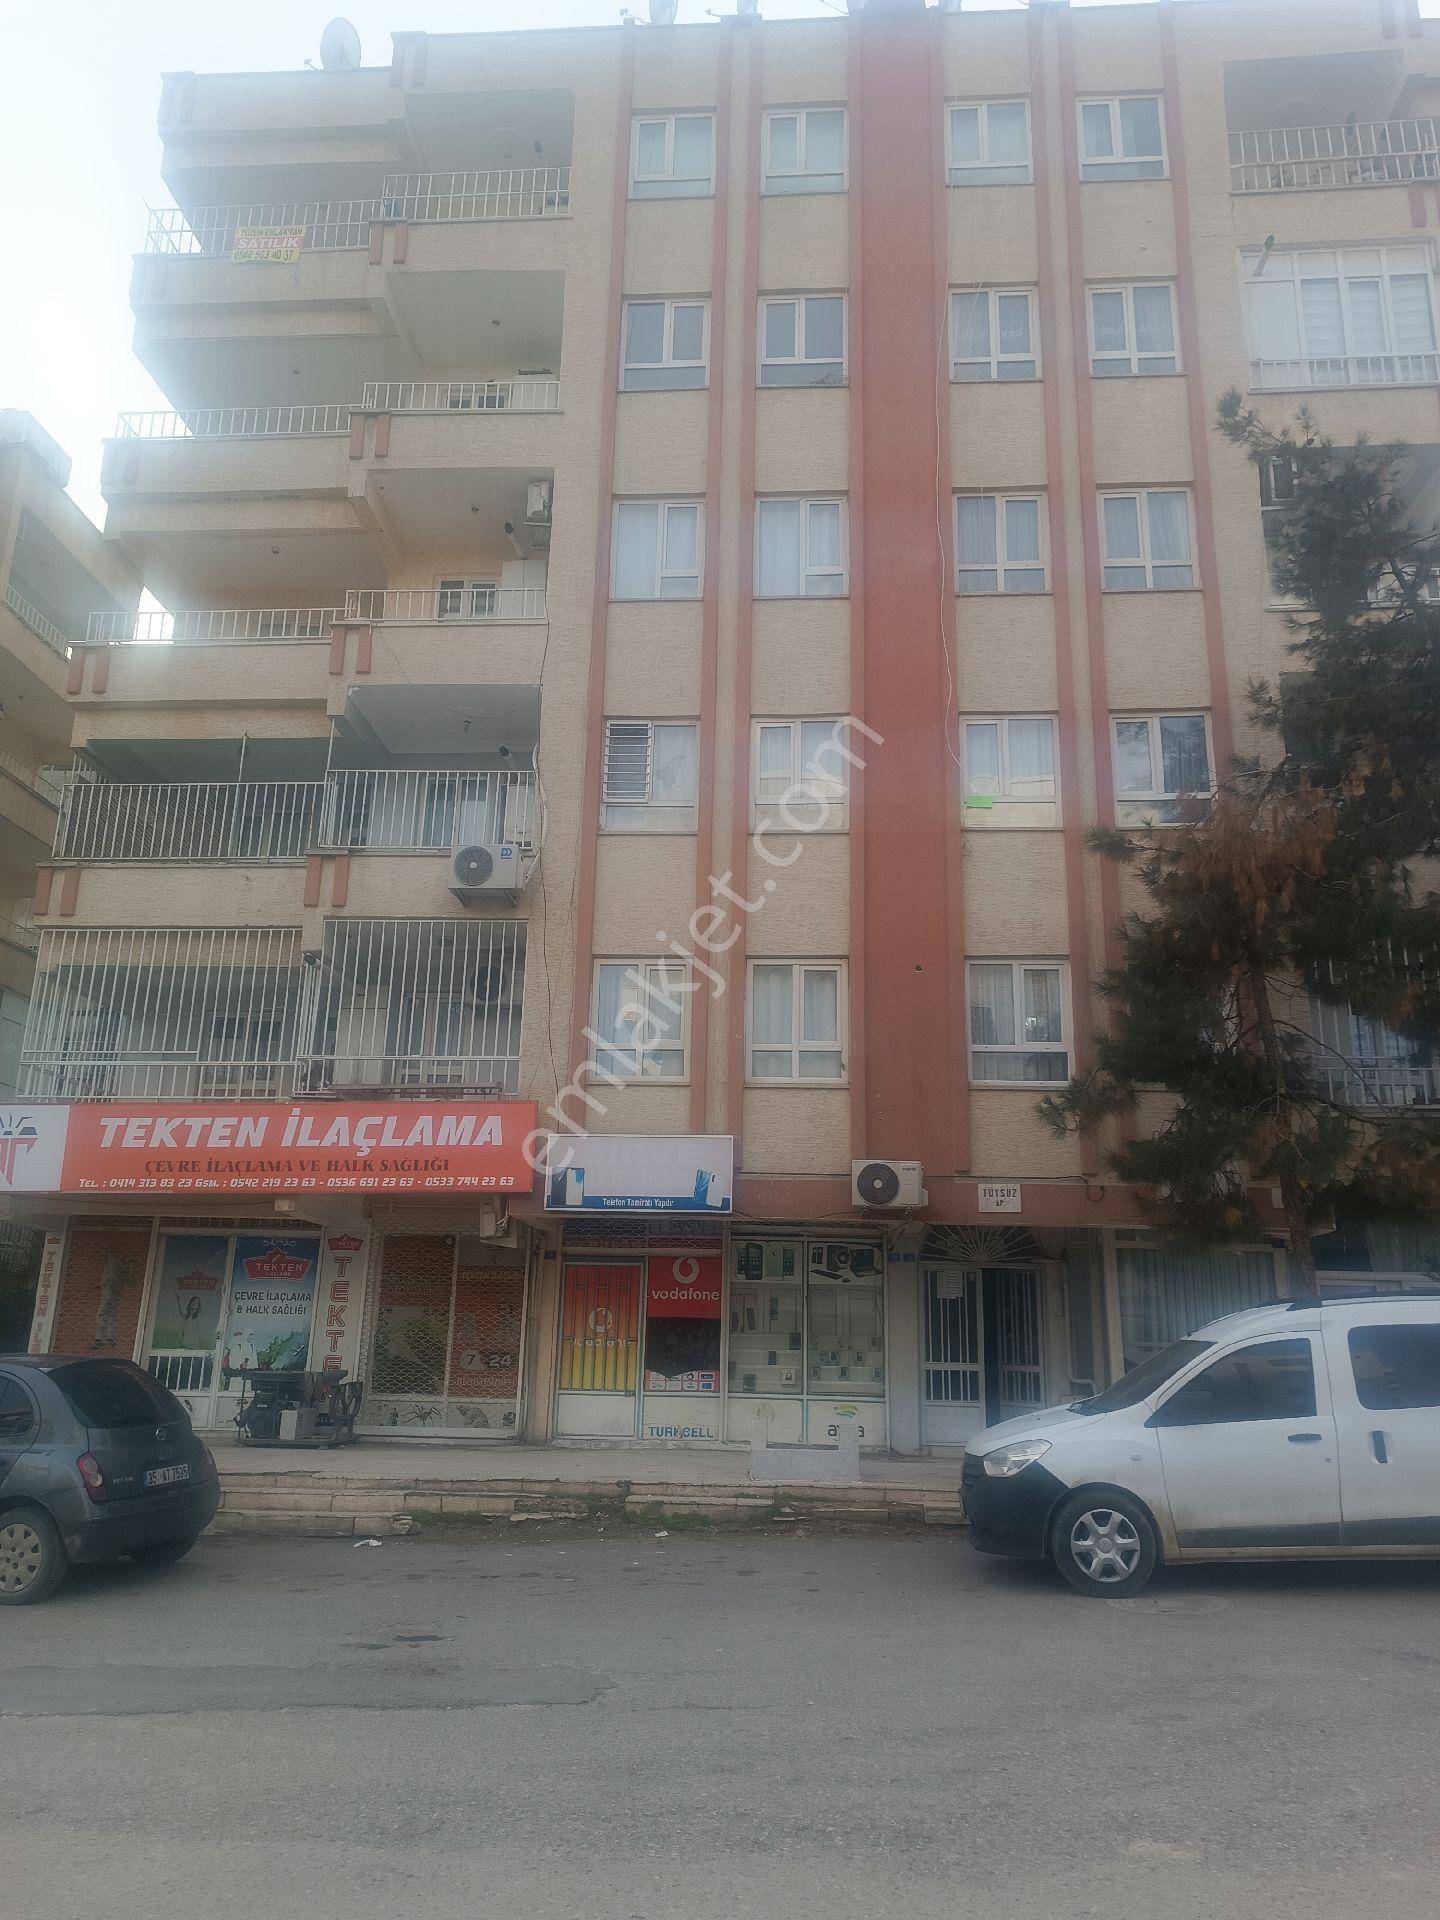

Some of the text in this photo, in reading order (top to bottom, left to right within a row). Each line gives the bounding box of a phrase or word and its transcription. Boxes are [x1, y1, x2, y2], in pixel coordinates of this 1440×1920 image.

[238, 237, 300, 249] SATILIK
[99, 1107, 503, 1157] TEKTEN İLAÇLAMA
[145, 1157, 449, 1175] ÇEVRE İLAÇLAMA VE HALK SAĞLIĞI
[109, 1178, 135, 1188] 0414
[138, 1178, 157, 1188] 313
[177, 1178, 192, 1188] 23
[230, 1178, 259, 1187] 0542
[261, 1177, 280, 1187] 219
[284, 1177, 298, 1187] 23
[301, 1177, 316, 1187] 63
[327, 1177, 357, 1187] 0536
[359, 1177, 378, 1187] 691
[382, 1177, 396, 1187] 23
[399, 1177, 414, 1187] 63
[424, 1177, 454, 1187] 0533
[457, 1176, 478, 1186] 744
[482, 1176, 496, 1186] 23
[499, 1176, 515, 1186] 63
[602, 1198, 626, 1207] Telefon
[255, 1263, 303, 1272] TEKTEN
[235, 1289, 312, 1303] ÇEVRE İLAÇLAMA
[651, 1287, 720, 1301] vodafone
[236, 1303, 307, 1315] & HALK SAĞLIĞI
